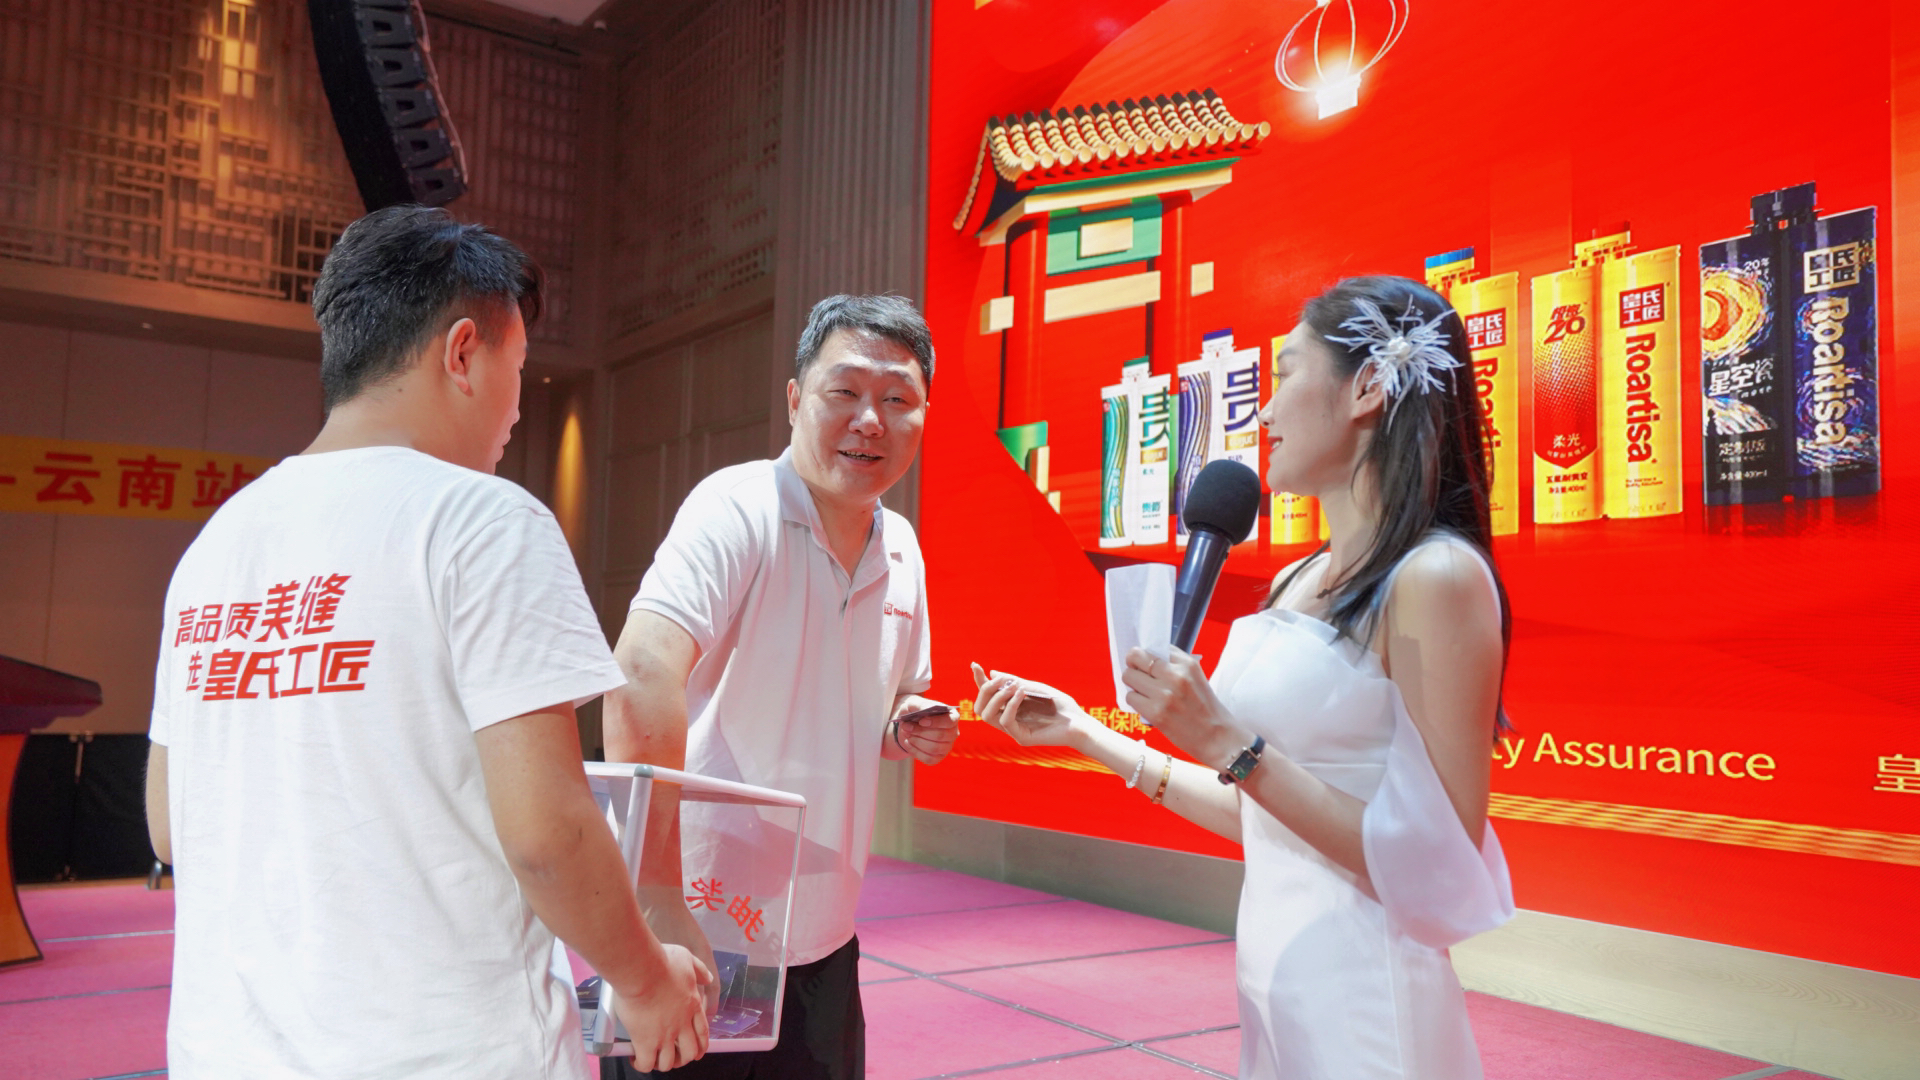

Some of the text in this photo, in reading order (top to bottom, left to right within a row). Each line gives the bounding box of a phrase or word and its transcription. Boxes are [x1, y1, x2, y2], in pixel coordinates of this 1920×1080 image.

[1622, 288, 1661, 310] 皇氏
[1623, 304, 1661, 325] 工匠
[1469, 328, 1503, 348] 工匠
[1544, 315, 1586, 345] 20
[1708, 357, 1774, 397] 星空瓷
[1812, 296, 1855, 447] Roartisa
[1625, 332, 1661, 464] Roartisa
[1553, 433, 1581, 449] 柔光
[174, 573, 352, 648] 高品质美缝
[1533, 731, 1777, 782] Assurance
